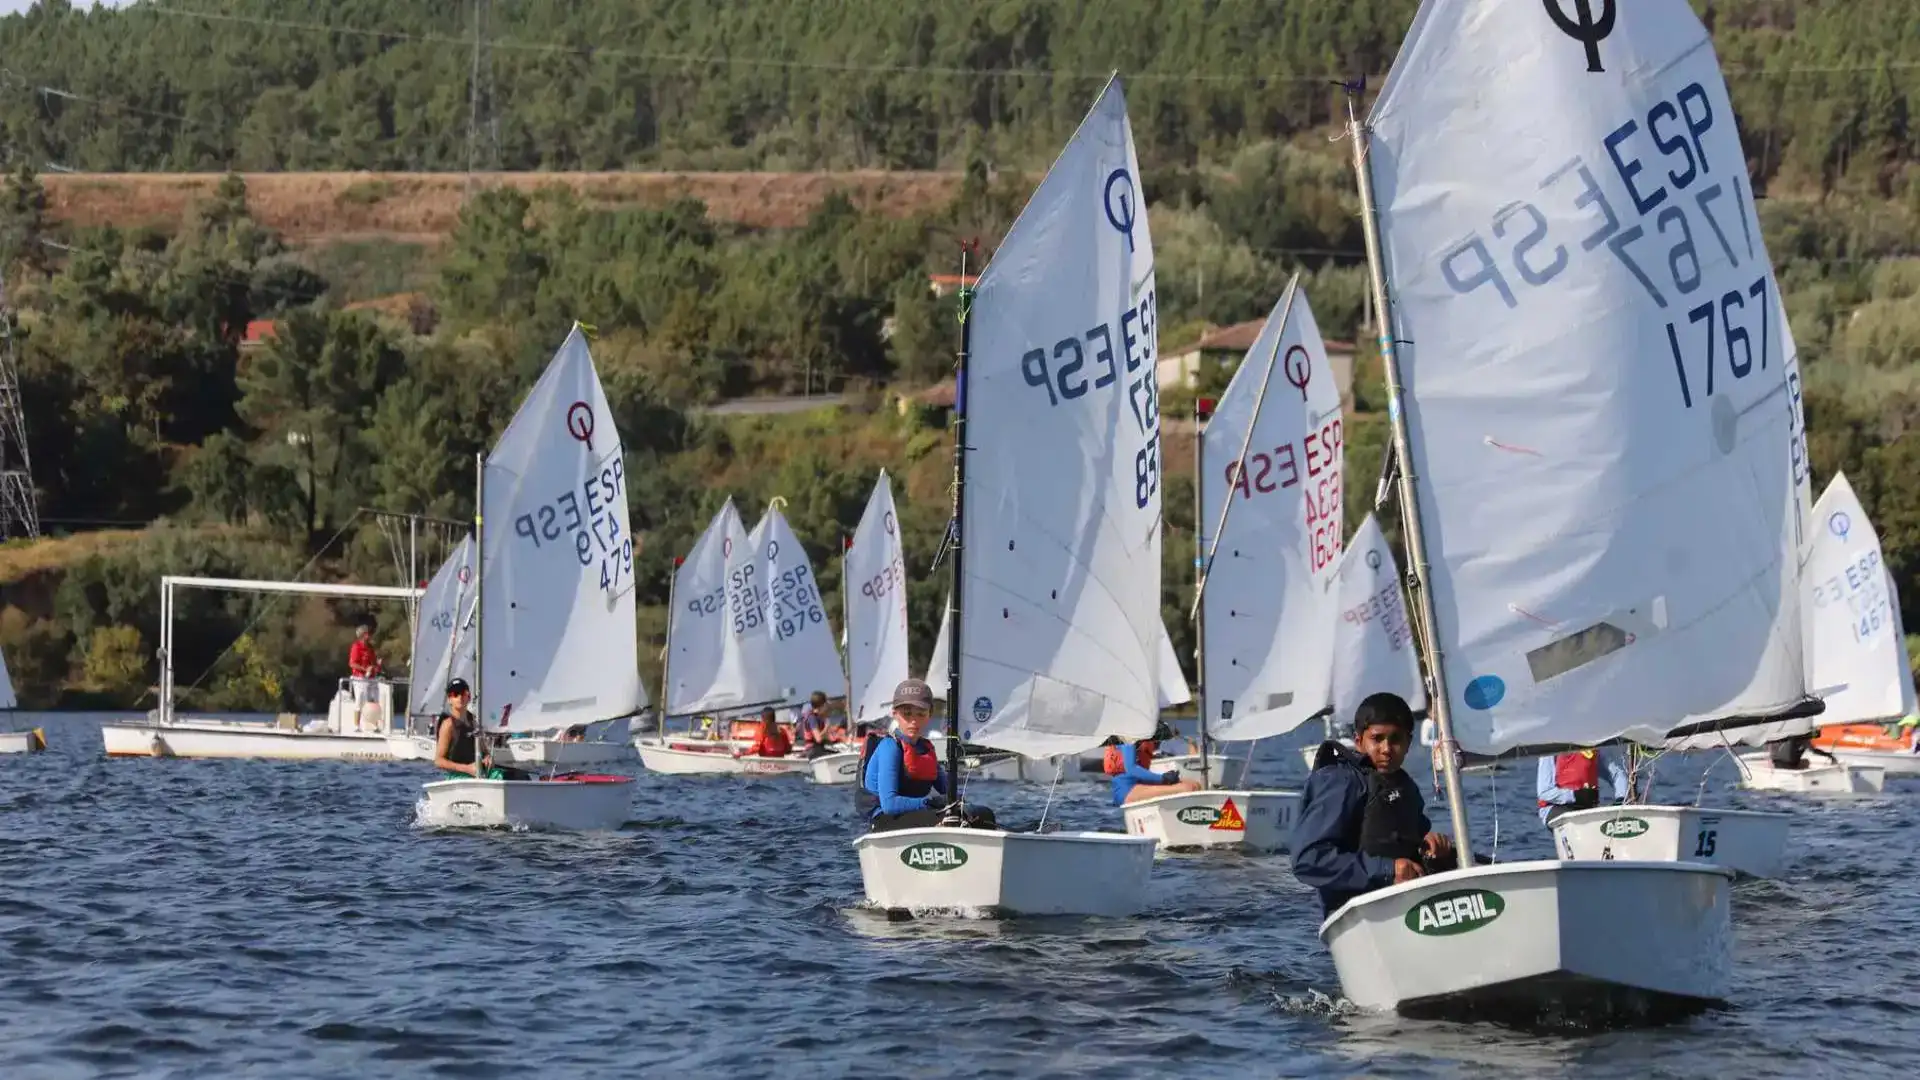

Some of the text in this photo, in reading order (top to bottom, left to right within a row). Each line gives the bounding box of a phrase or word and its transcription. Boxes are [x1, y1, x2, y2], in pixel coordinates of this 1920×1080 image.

[1603, 81, 1714, 216] ESP
[1121, 290, 1155, 373] ESP
[1666, 276, 1767, 408] 1767
[1303, 420, 1341, 477] ESP
[584, 458, 624, 516] ESP
[599, 538, 631, 592] 479
[732, 564, 754, 589] SP
[771, 564, 807, 598] ESP
[1845, 549, 1878, 590] ESP
[734, 605, 764, 634] 551
[776, 604, 823, 641] 1976
[1181, 808, 1219, 822] ABRIL
[1605, 820, 1646, 835] ABRIL
[907, 845, 963, 866] ABRIL
[1695, 830, 1717, 857] 15
[1418, 893, 1497, 931] ABRIL
